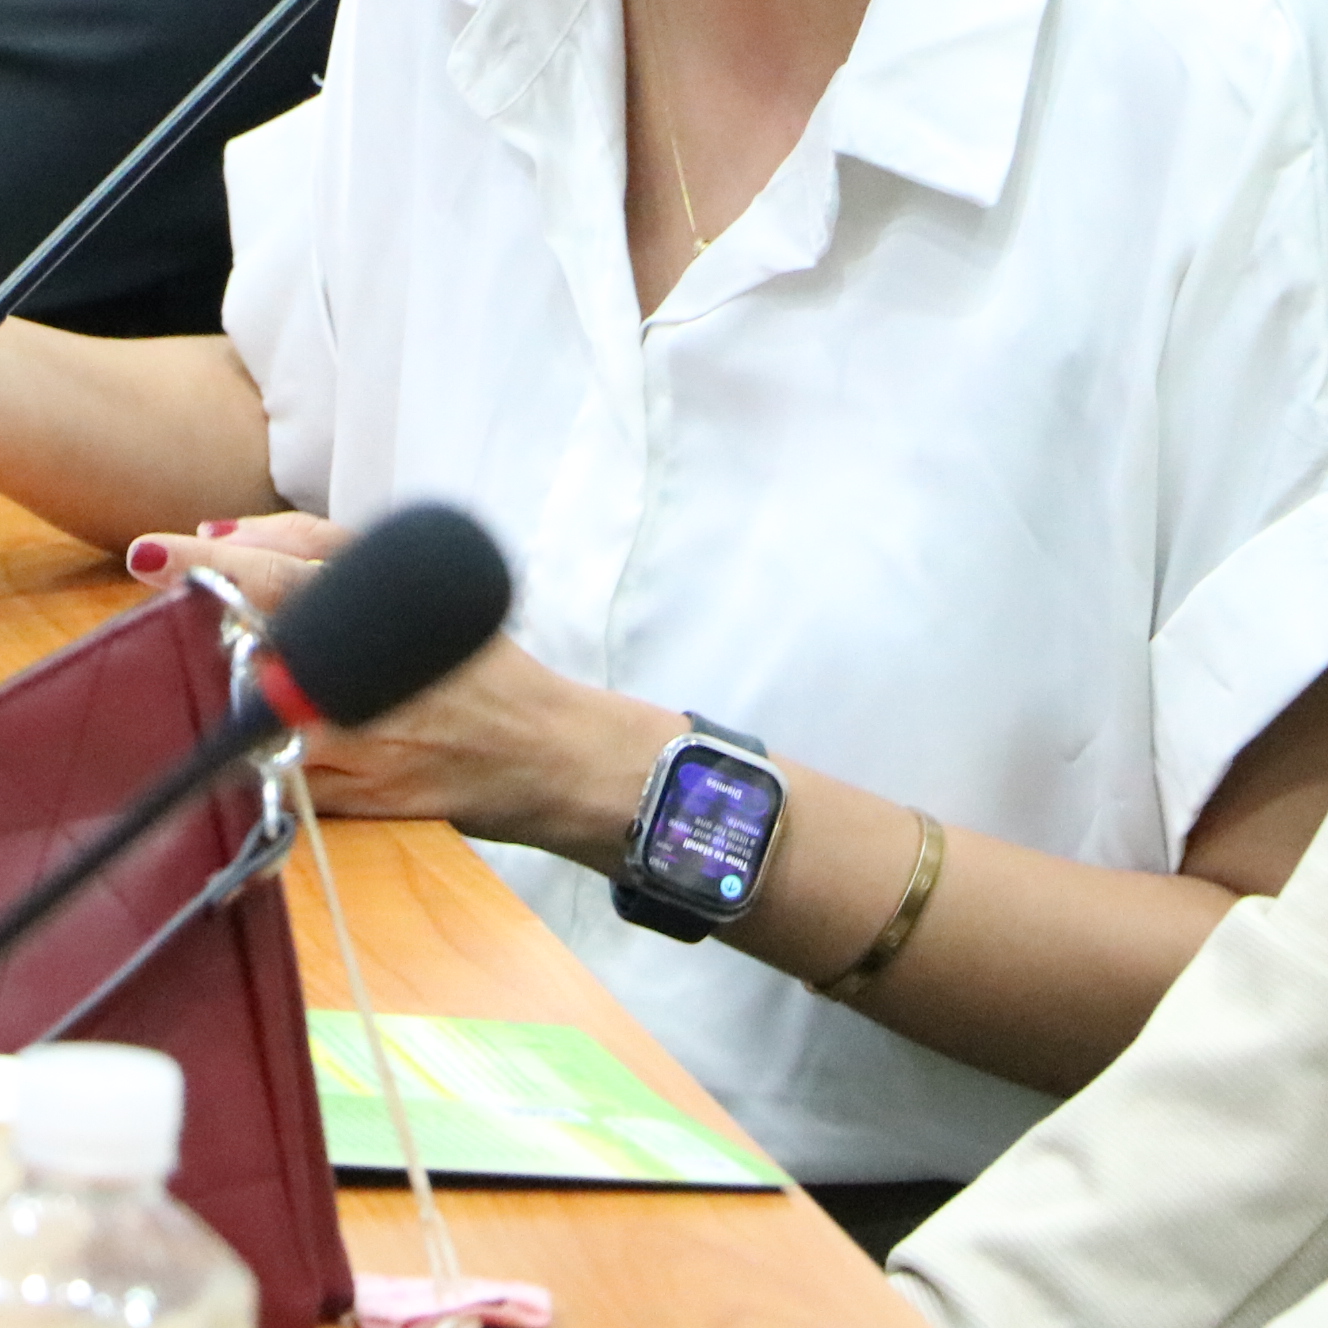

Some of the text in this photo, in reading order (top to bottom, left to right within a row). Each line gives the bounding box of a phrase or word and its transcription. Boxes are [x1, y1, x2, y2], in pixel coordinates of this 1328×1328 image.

[706, 776, 743, 801] Dismiss
[694, 816, 713, 829] one
[712, 824, 727, 837] for
[667, 818, 752, 860] Stand up and move
[727, 828, 749, 844] little
[713, 849, 725, 863] to
[725, 854, 749, 872] Time
